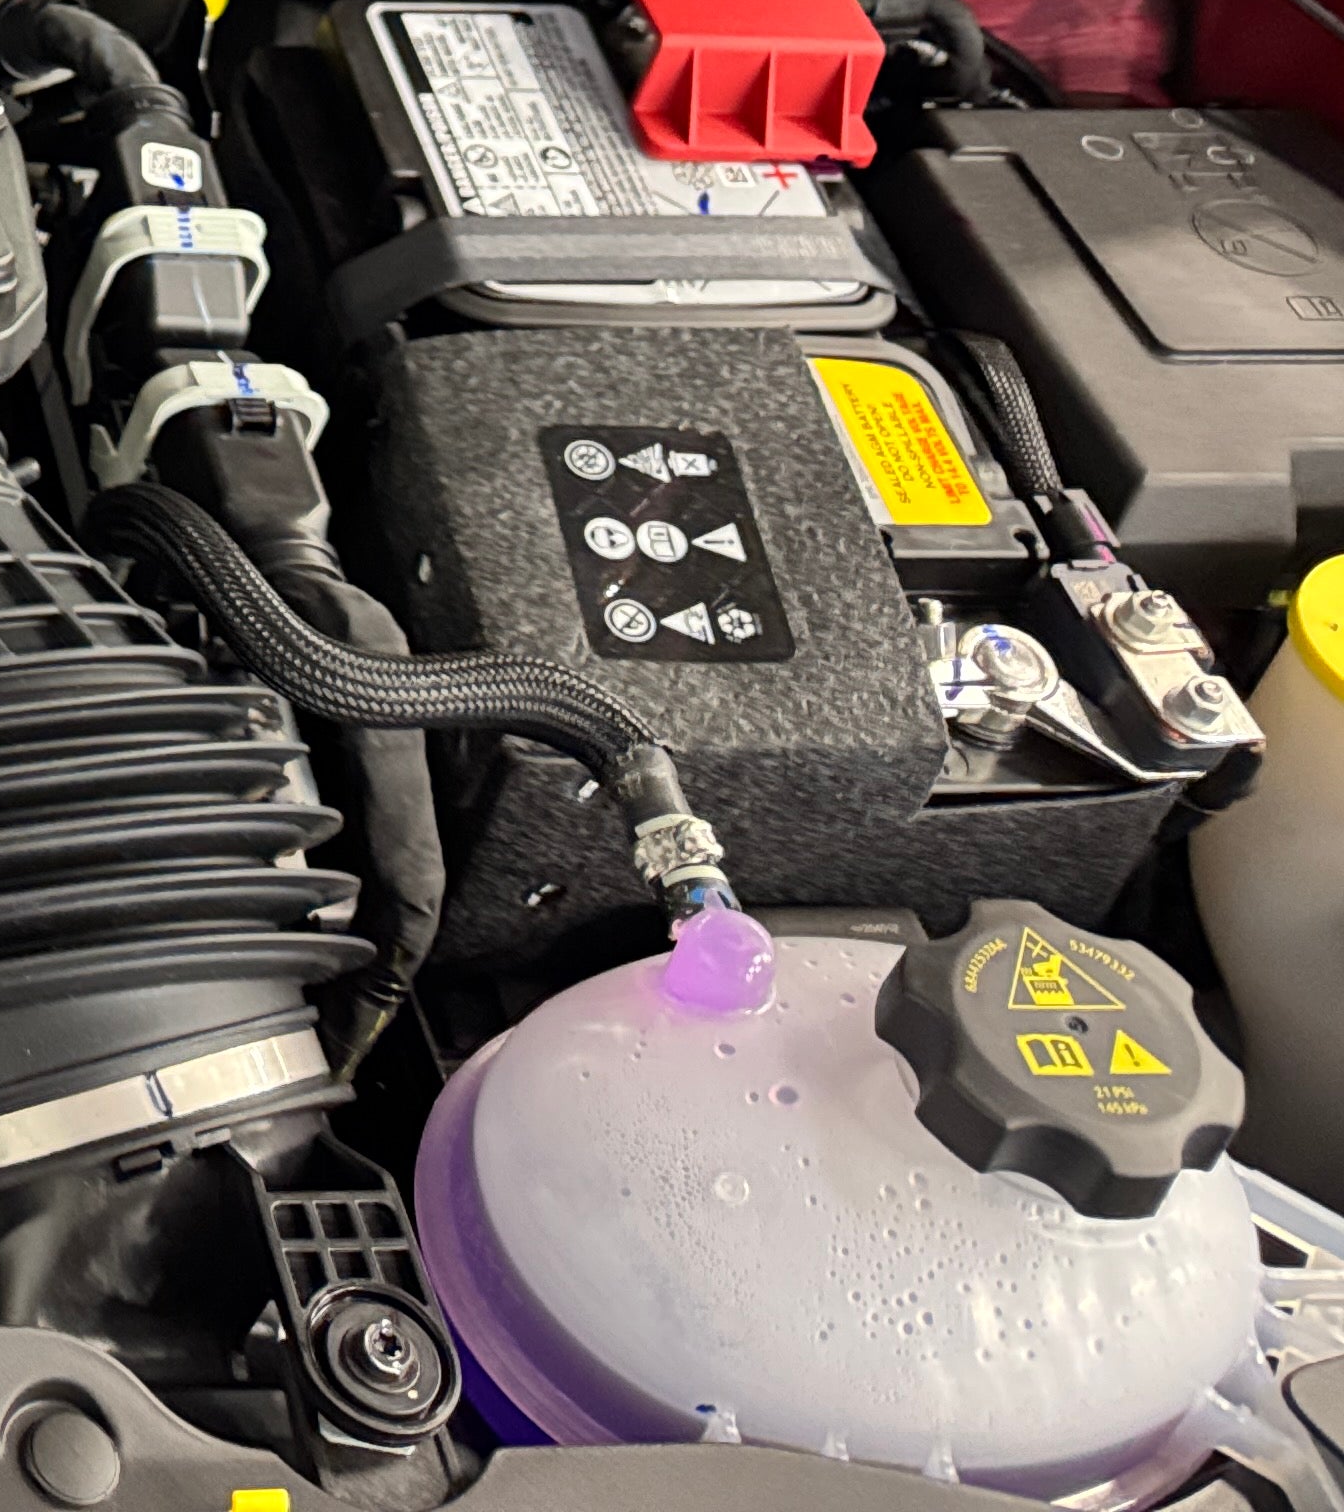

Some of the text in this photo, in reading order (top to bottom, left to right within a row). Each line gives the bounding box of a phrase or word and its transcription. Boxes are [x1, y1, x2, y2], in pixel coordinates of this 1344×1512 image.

[883, 440, 904, 463] NOT
[897, 464, 915, 482] DO
[1093, 1084, 1112, 1100] 21
